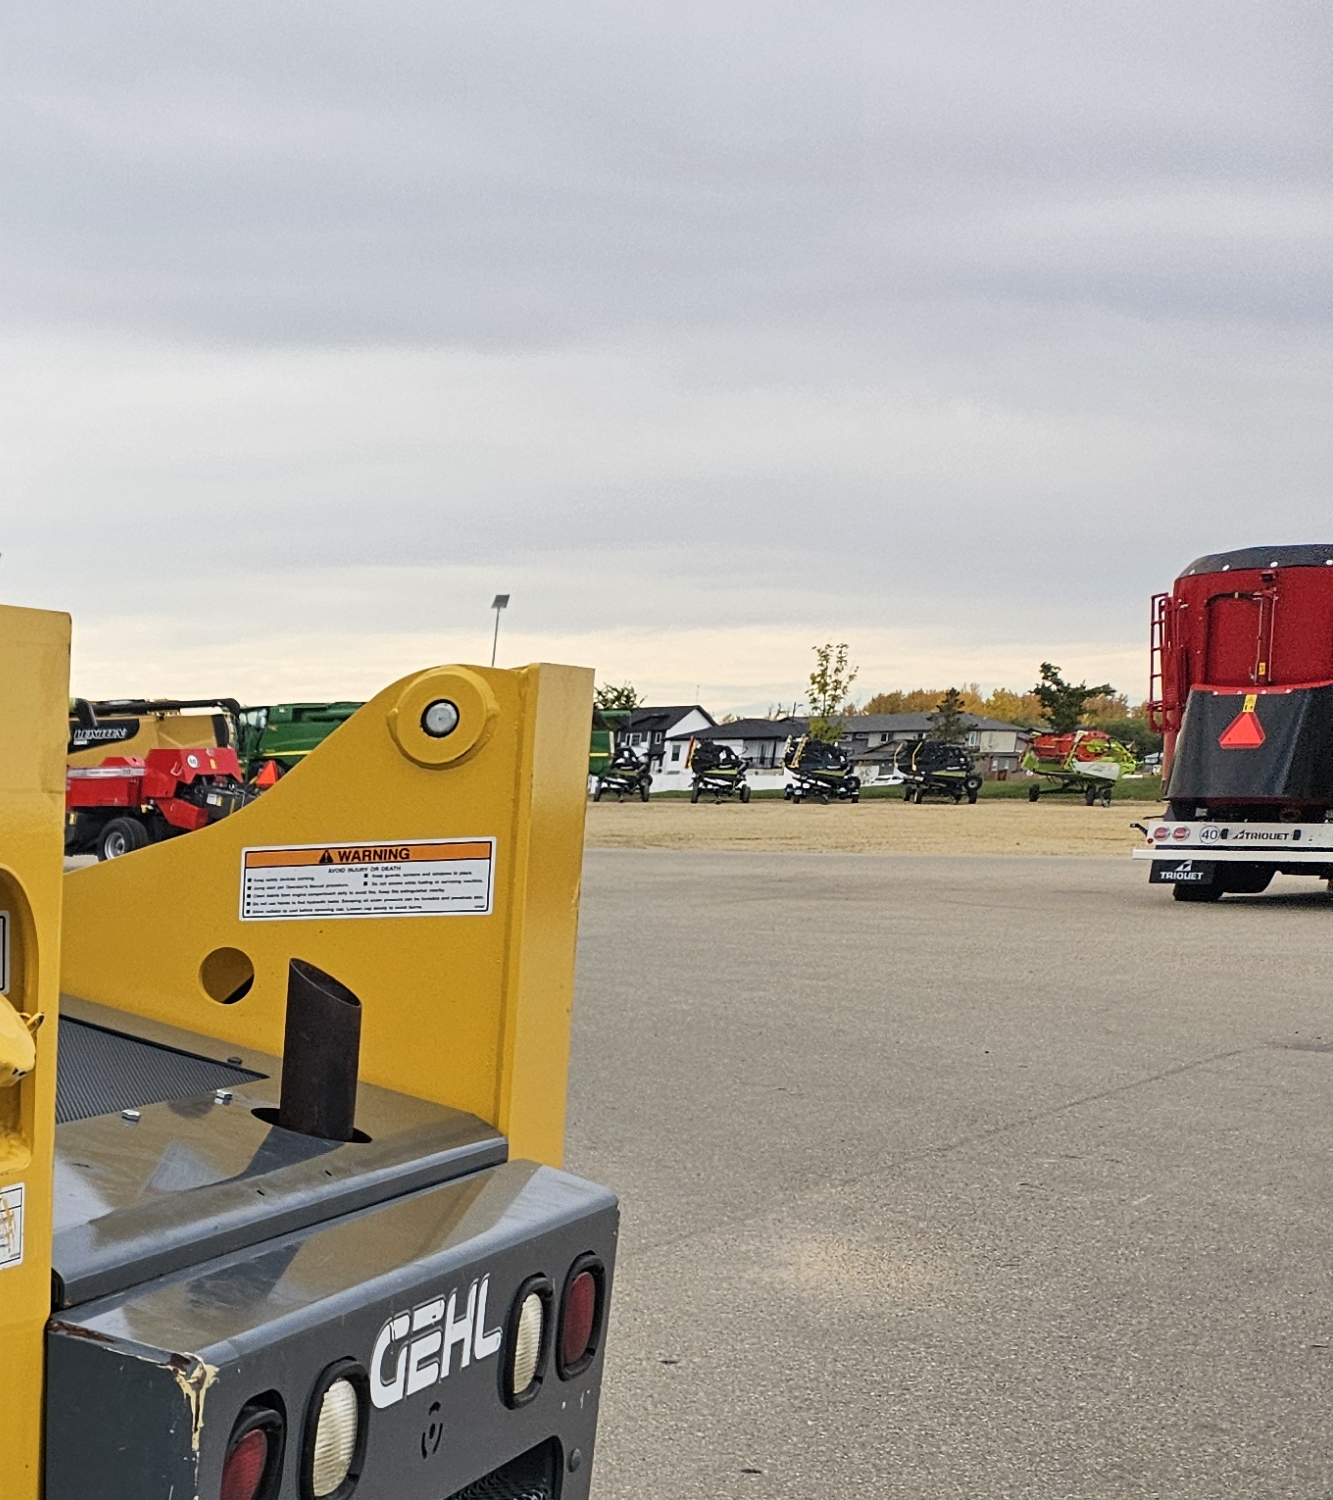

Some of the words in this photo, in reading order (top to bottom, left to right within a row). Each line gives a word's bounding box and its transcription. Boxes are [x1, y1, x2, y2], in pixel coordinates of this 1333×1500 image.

[1201, 829, 1218, 840] 40
[338, 848, 410, 862] WARNING
[369, 1272, 504, 1409] GEHL
